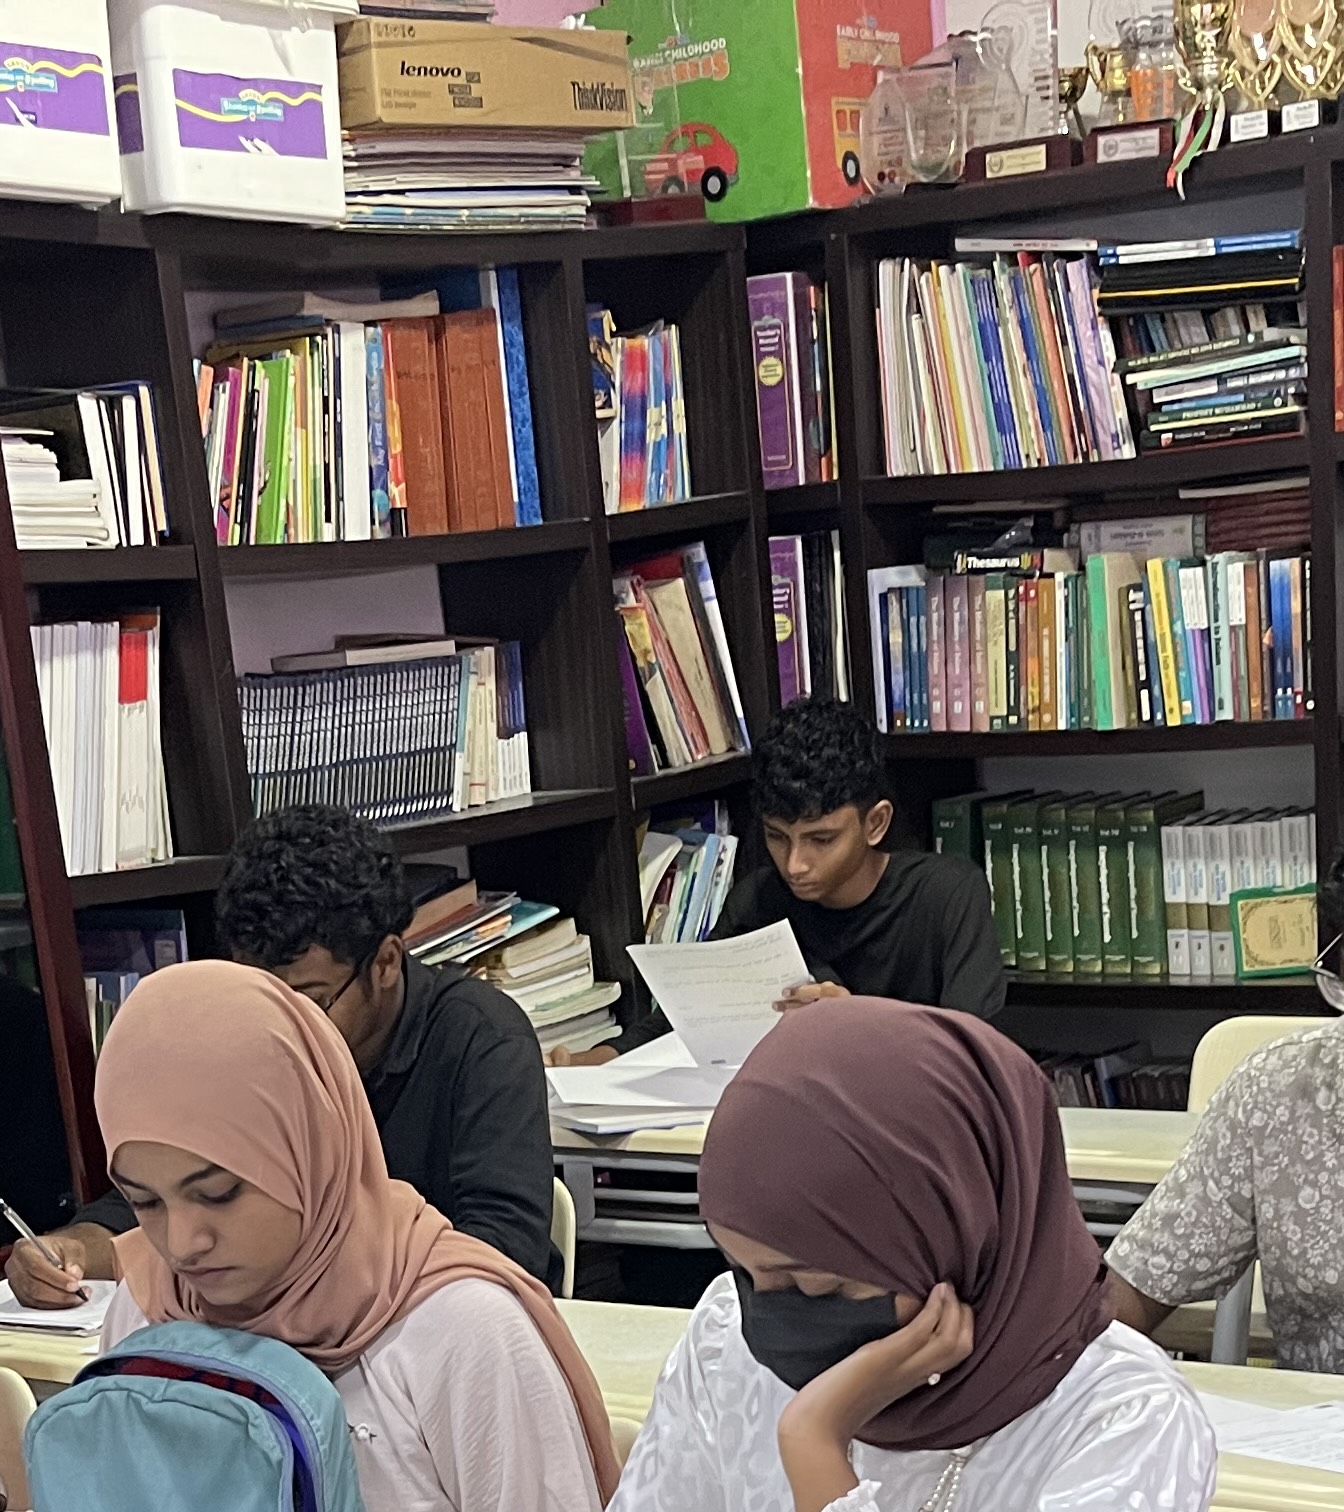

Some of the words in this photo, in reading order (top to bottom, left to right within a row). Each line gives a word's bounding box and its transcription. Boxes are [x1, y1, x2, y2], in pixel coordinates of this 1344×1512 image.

[664, 37, 727, 61] CHILDHOOD
[400, 60, 462, 78] lenovo
[570, 80, 627, 112] ThinkVision
[966, 556, 1020, 569] Thesaurus
